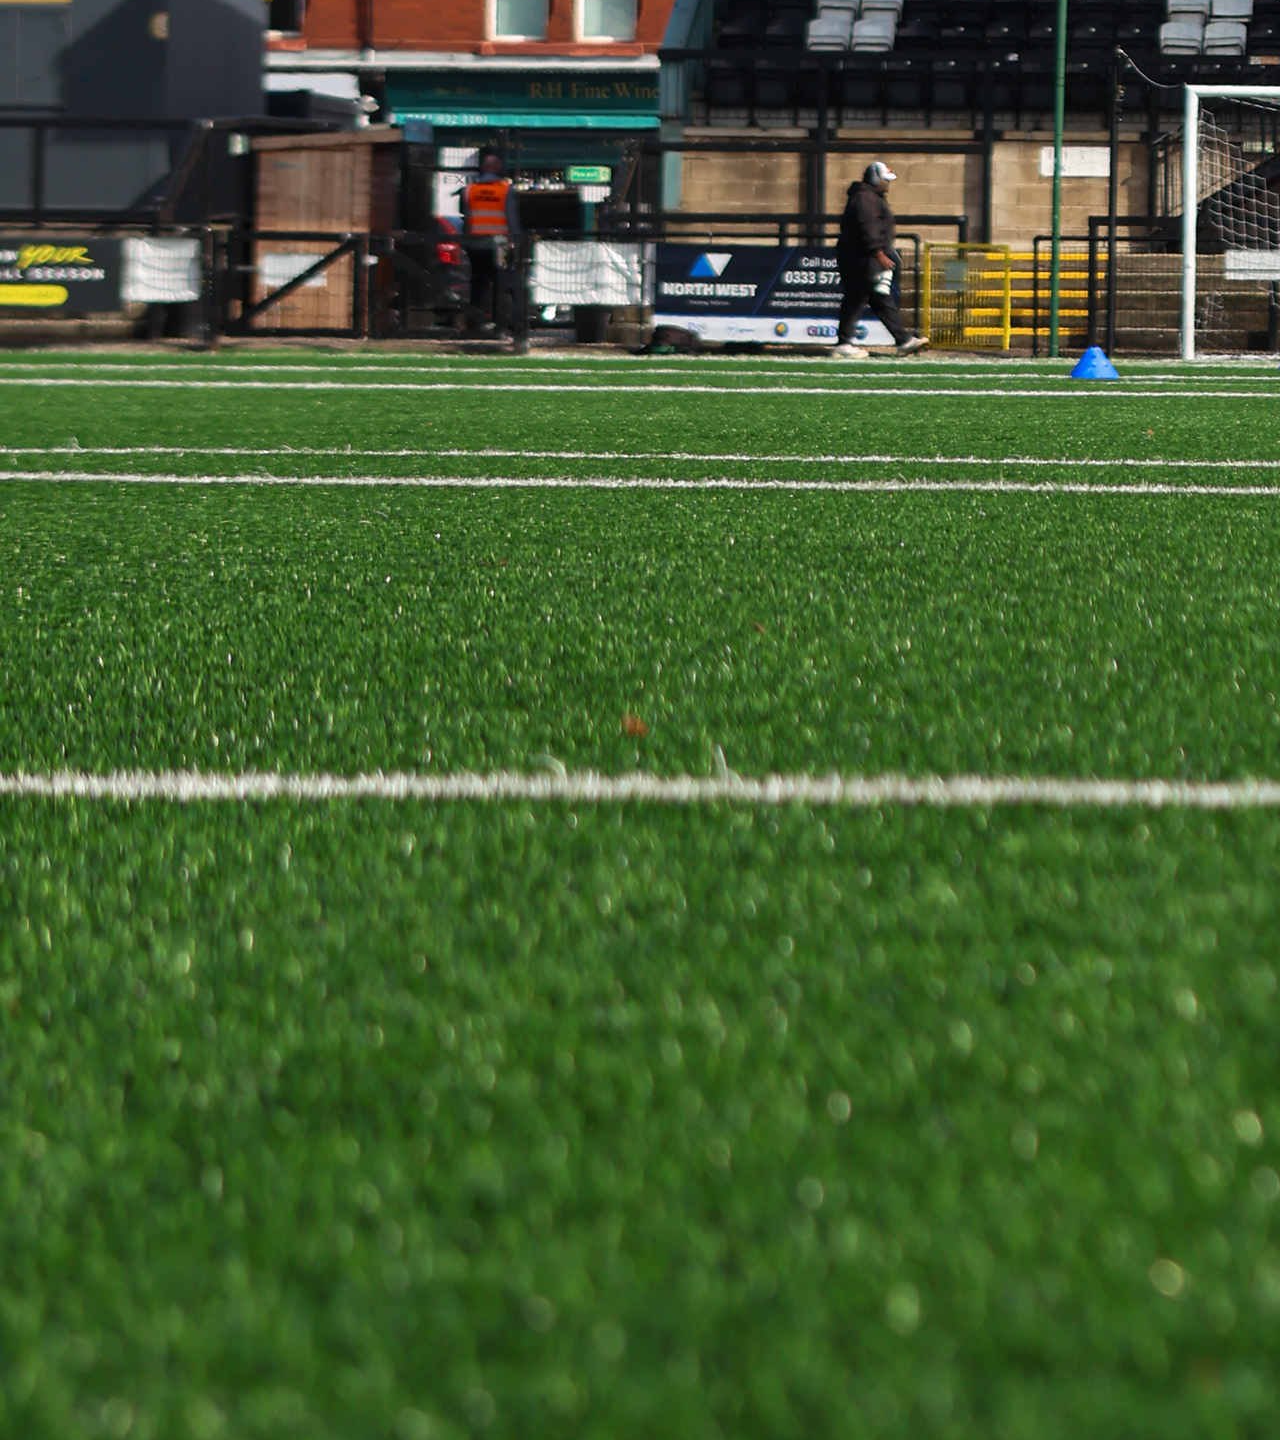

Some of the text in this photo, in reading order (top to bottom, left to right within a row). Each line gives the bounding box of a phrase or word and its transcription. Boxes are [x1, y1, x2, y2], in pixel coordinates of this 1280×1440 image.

[530, 81, 562, 99] RH
[571, 81, 609, 99] Fine
[801, 256, 839, 268] Call tod
[29, 267, 105, 281] SEASON
[784, 270, 816, 284] 0333
[662, 281, 758, 297] NORTH WEST
